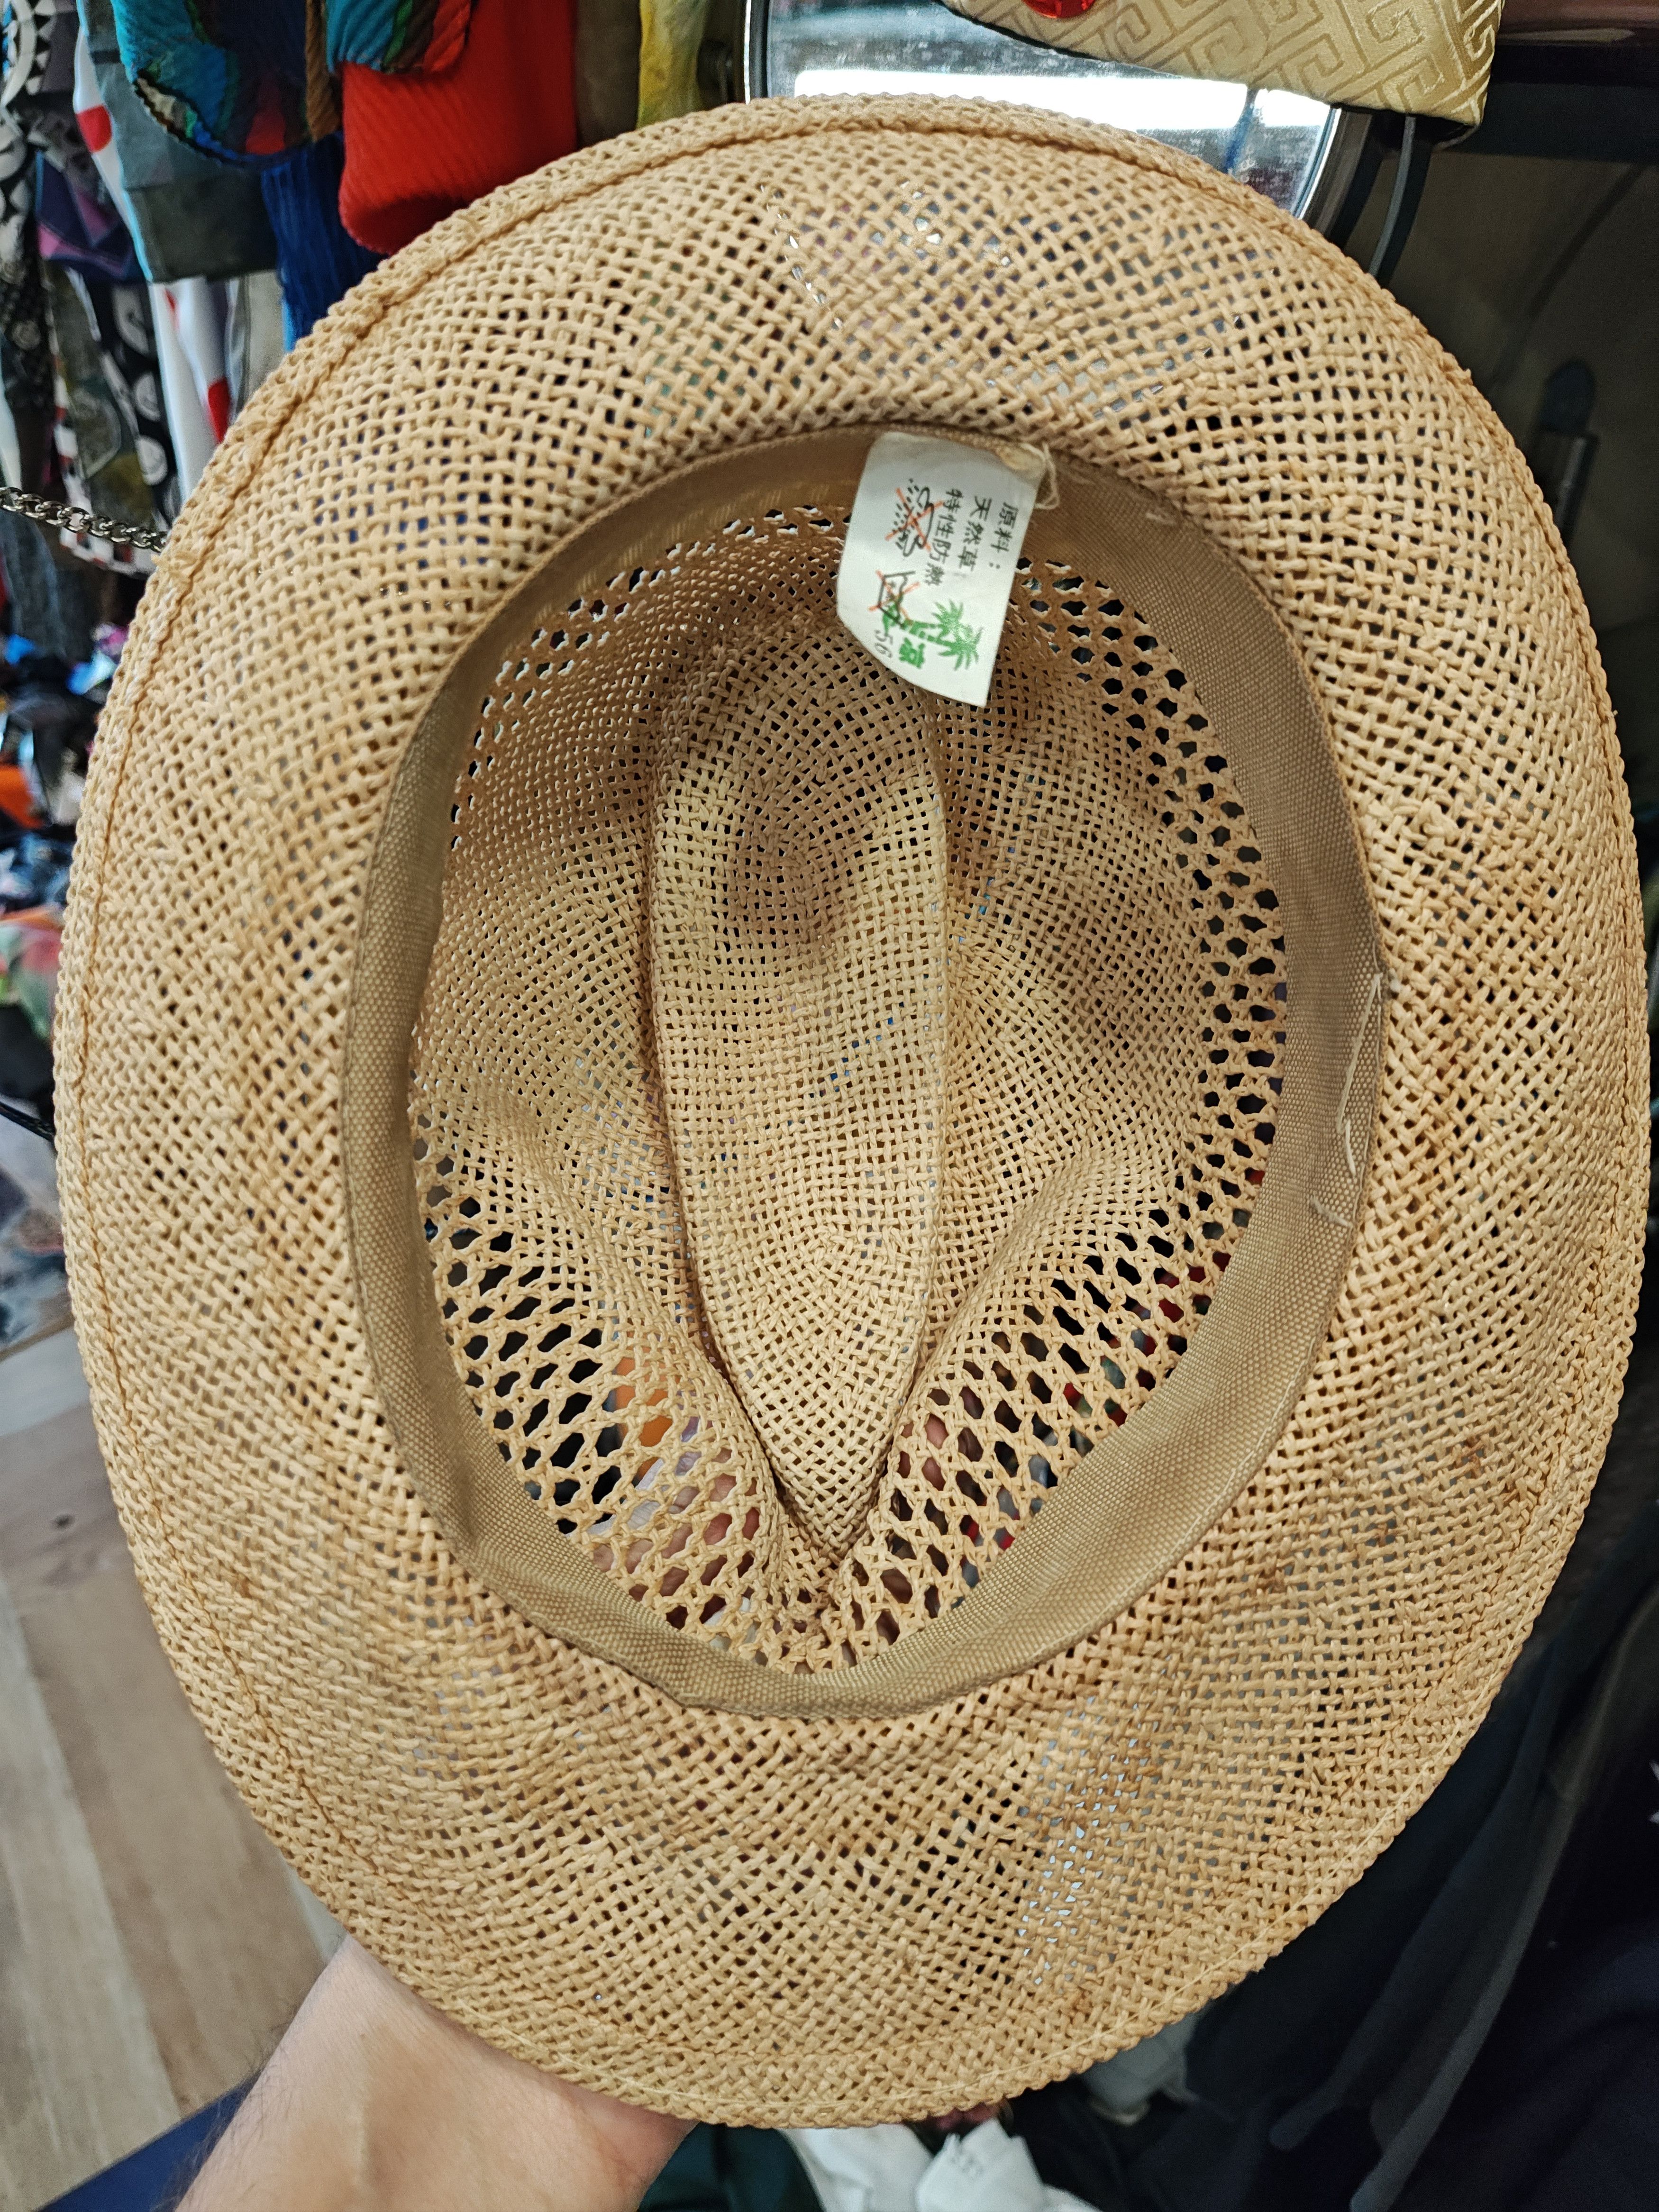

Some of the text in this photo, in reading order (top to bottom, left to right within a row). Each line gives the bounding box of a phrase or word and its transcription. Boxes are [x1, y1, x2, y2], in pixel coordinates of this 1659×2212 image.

[925, 488, 964, 586] 特性防熱
[957, 495, 992, 572] 天然草
[875, 629, 893, 658] 56
